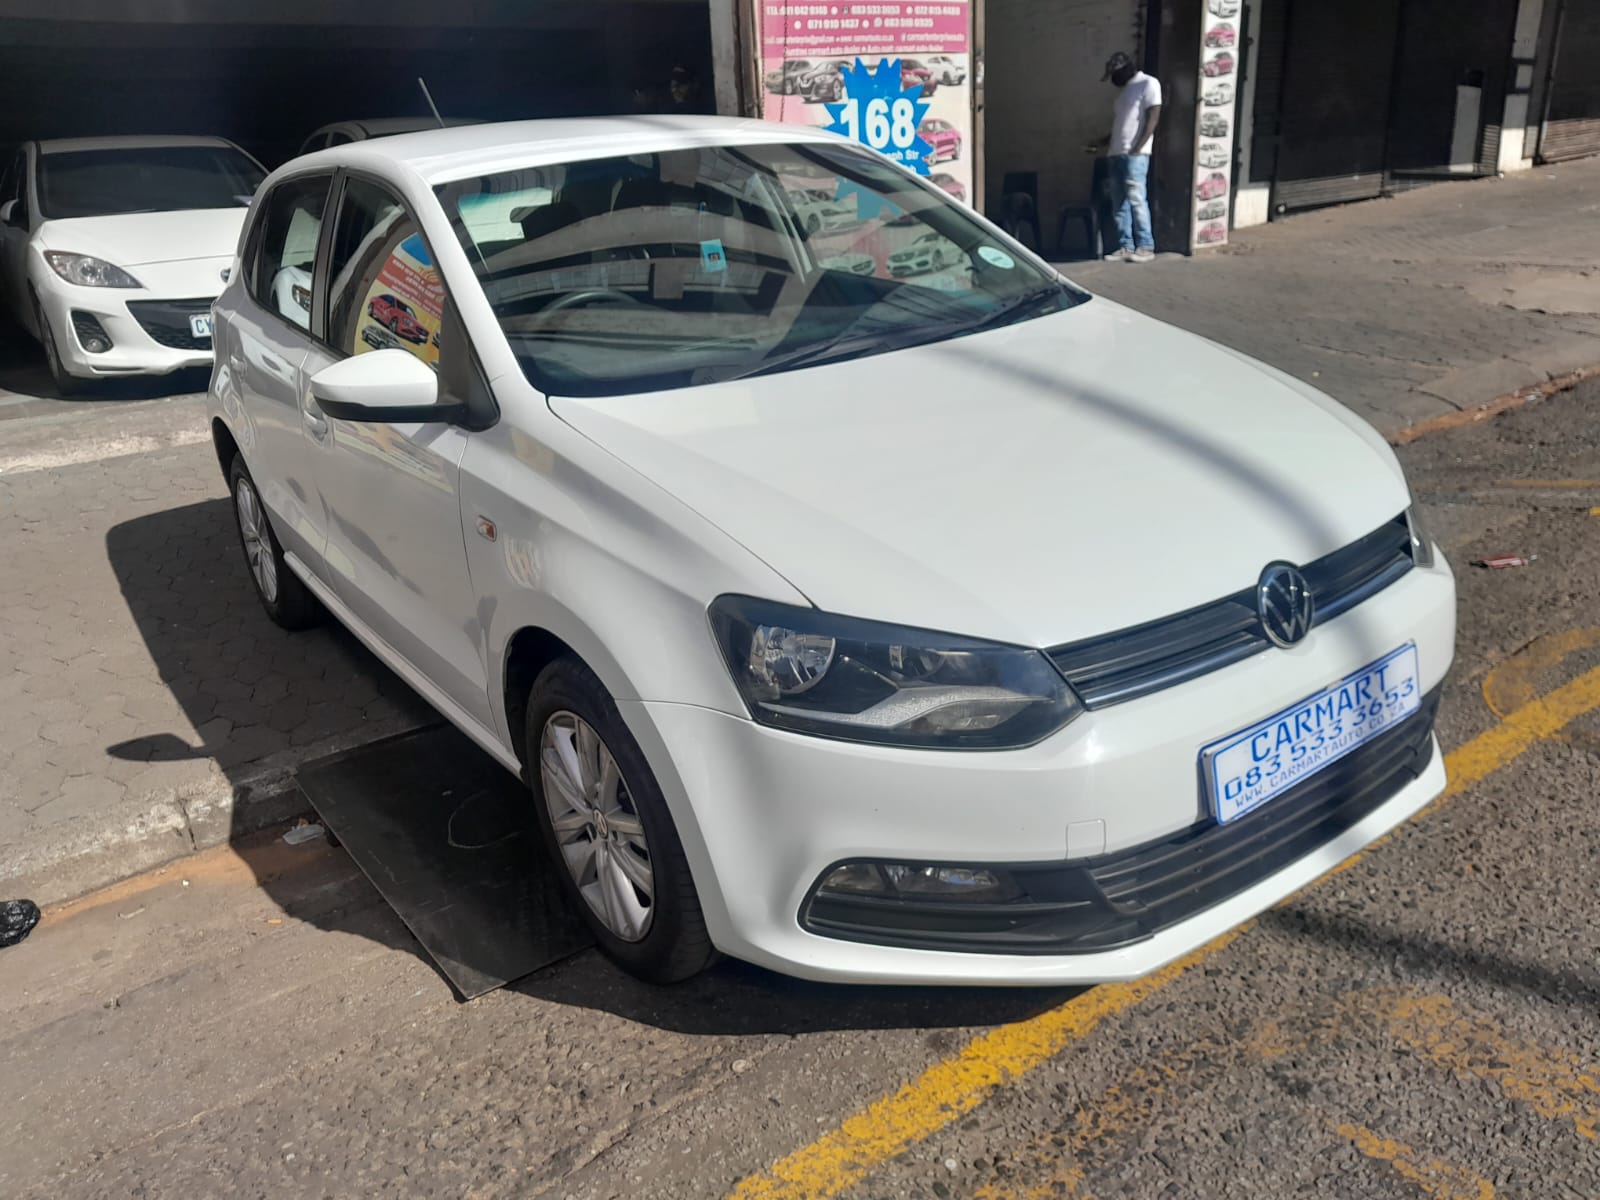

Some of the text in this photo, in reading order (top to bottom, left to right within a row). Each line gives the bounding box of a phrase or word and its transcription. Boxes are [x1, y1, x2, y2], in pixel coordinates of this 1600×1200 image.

[840, 97, 916, 150] 168
[1224, 676, 1414, 801] 083 533 3653
[1251, 664, 1390, 762] CARMART
